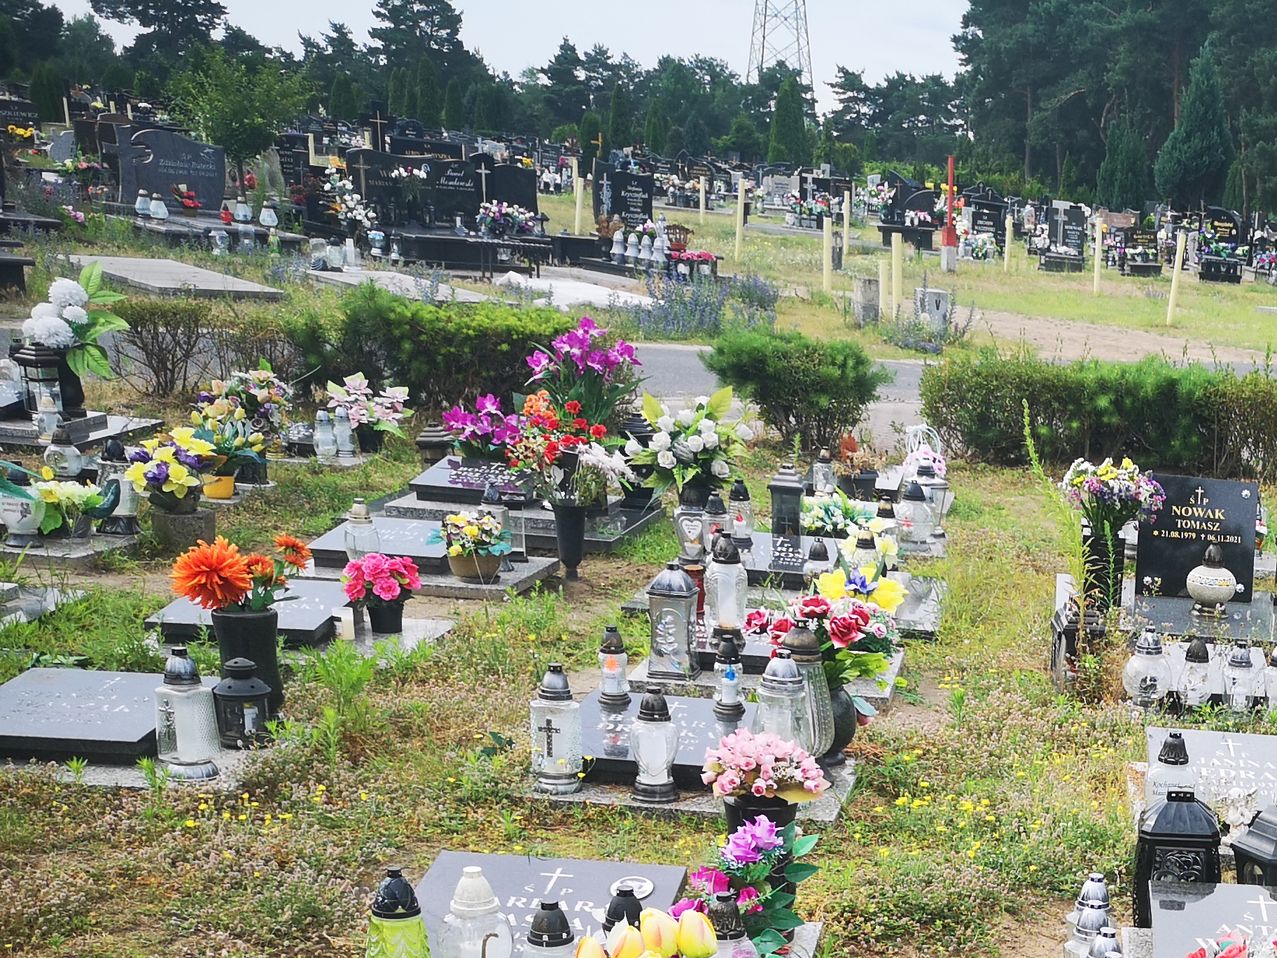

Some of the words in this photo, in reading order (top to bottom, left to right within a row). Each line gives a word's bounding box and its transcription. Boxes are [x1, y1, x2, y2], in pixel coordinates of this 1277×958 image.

[1203, 497, 1209, 506] P
[1171, 505, 1226, 520] NOWAK
[1175, 519, 1221, 532] TOMASZ
[1161, 530, 1197, 540] 21.08.1979
[560, 888, 574, 896] P
